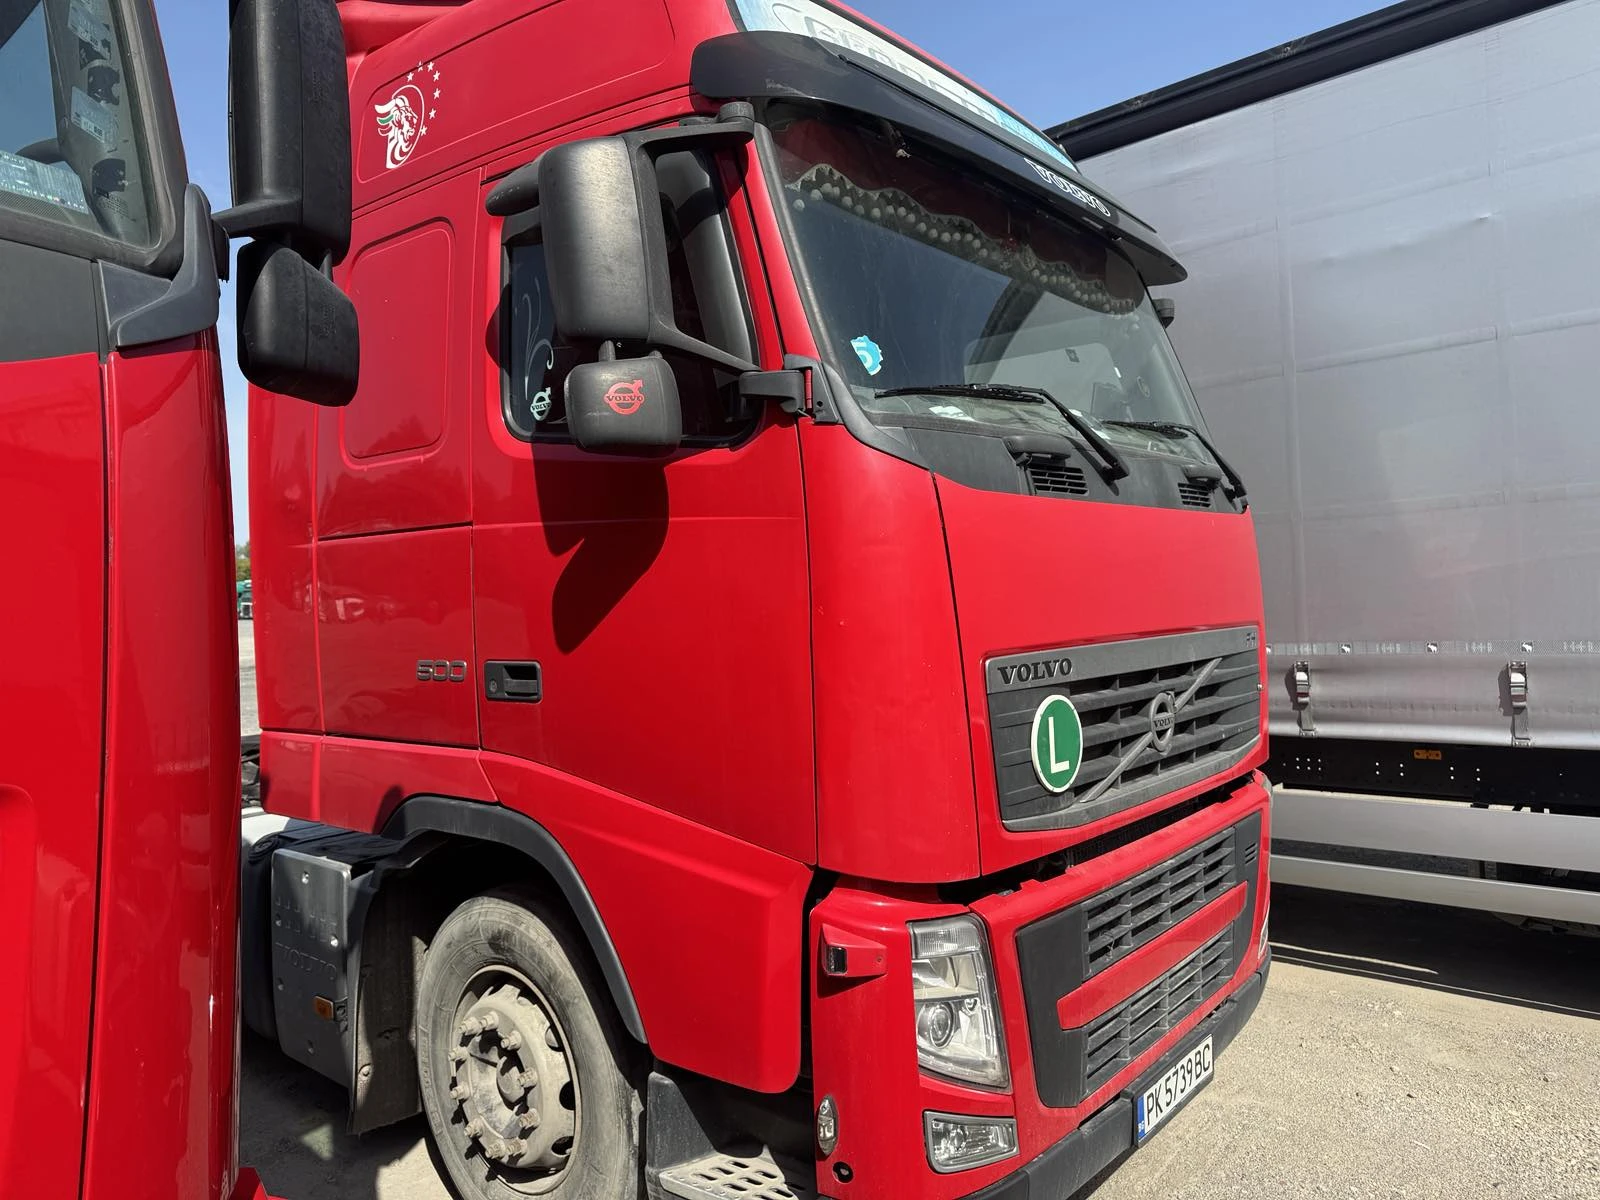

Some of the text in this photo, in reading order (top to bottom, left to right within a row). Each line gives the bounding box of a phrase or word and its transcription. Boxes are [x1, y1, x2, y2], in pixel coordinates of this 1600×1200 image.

[1023, 157, 1111, 217] VOLVO
[416, 659, 468, 682] 500
[996, 657, 1073, 685] VOLVO
[1048, 716, 1071, 774] L
[1145, 1043, 1211, 1127] PK 5739 BC
